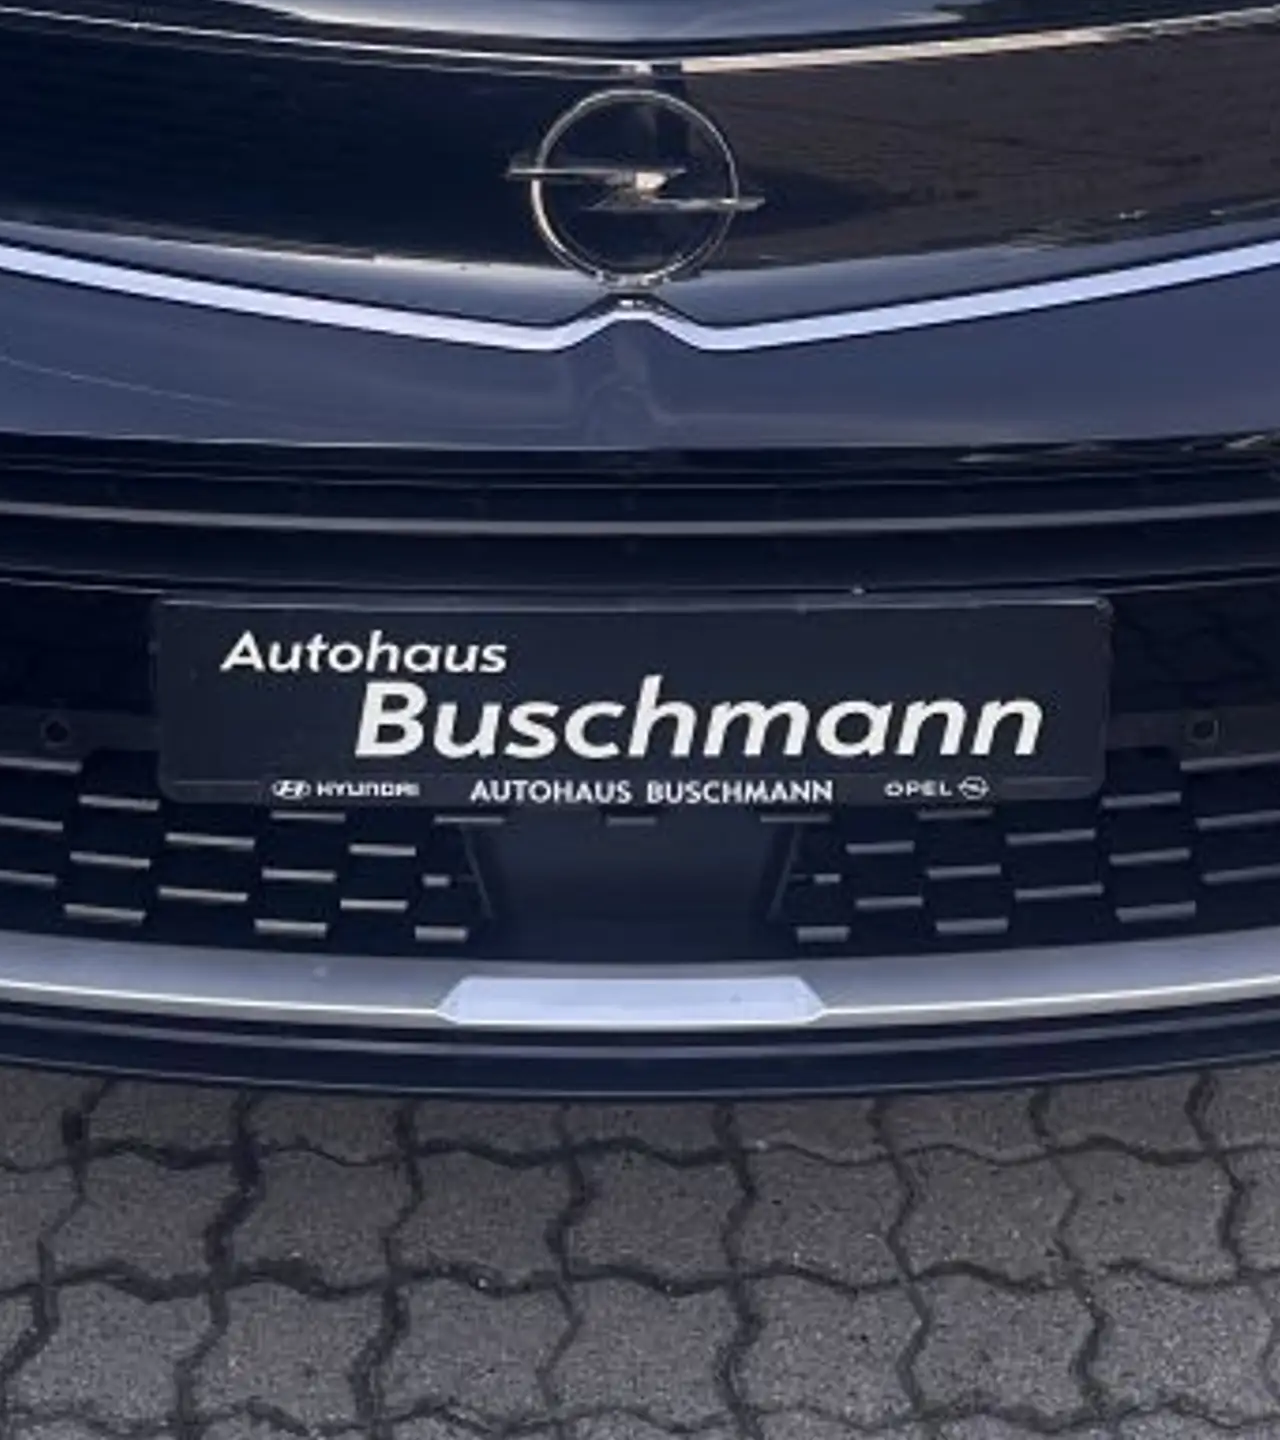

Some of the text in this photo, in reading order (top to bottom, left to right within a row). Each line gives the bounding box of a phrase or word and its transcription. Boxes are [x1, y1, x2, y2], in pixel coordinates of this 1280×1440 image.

[219, 629, 508, 674] Autohaus
[354, 674, 1044, 759] Buschmann
[316, 780, 421, 798] HYUNDAI
[469, 778, 834, 806] AUTOHAUS BUSCHMANN
[884, 779, 954, 799] OPEL
